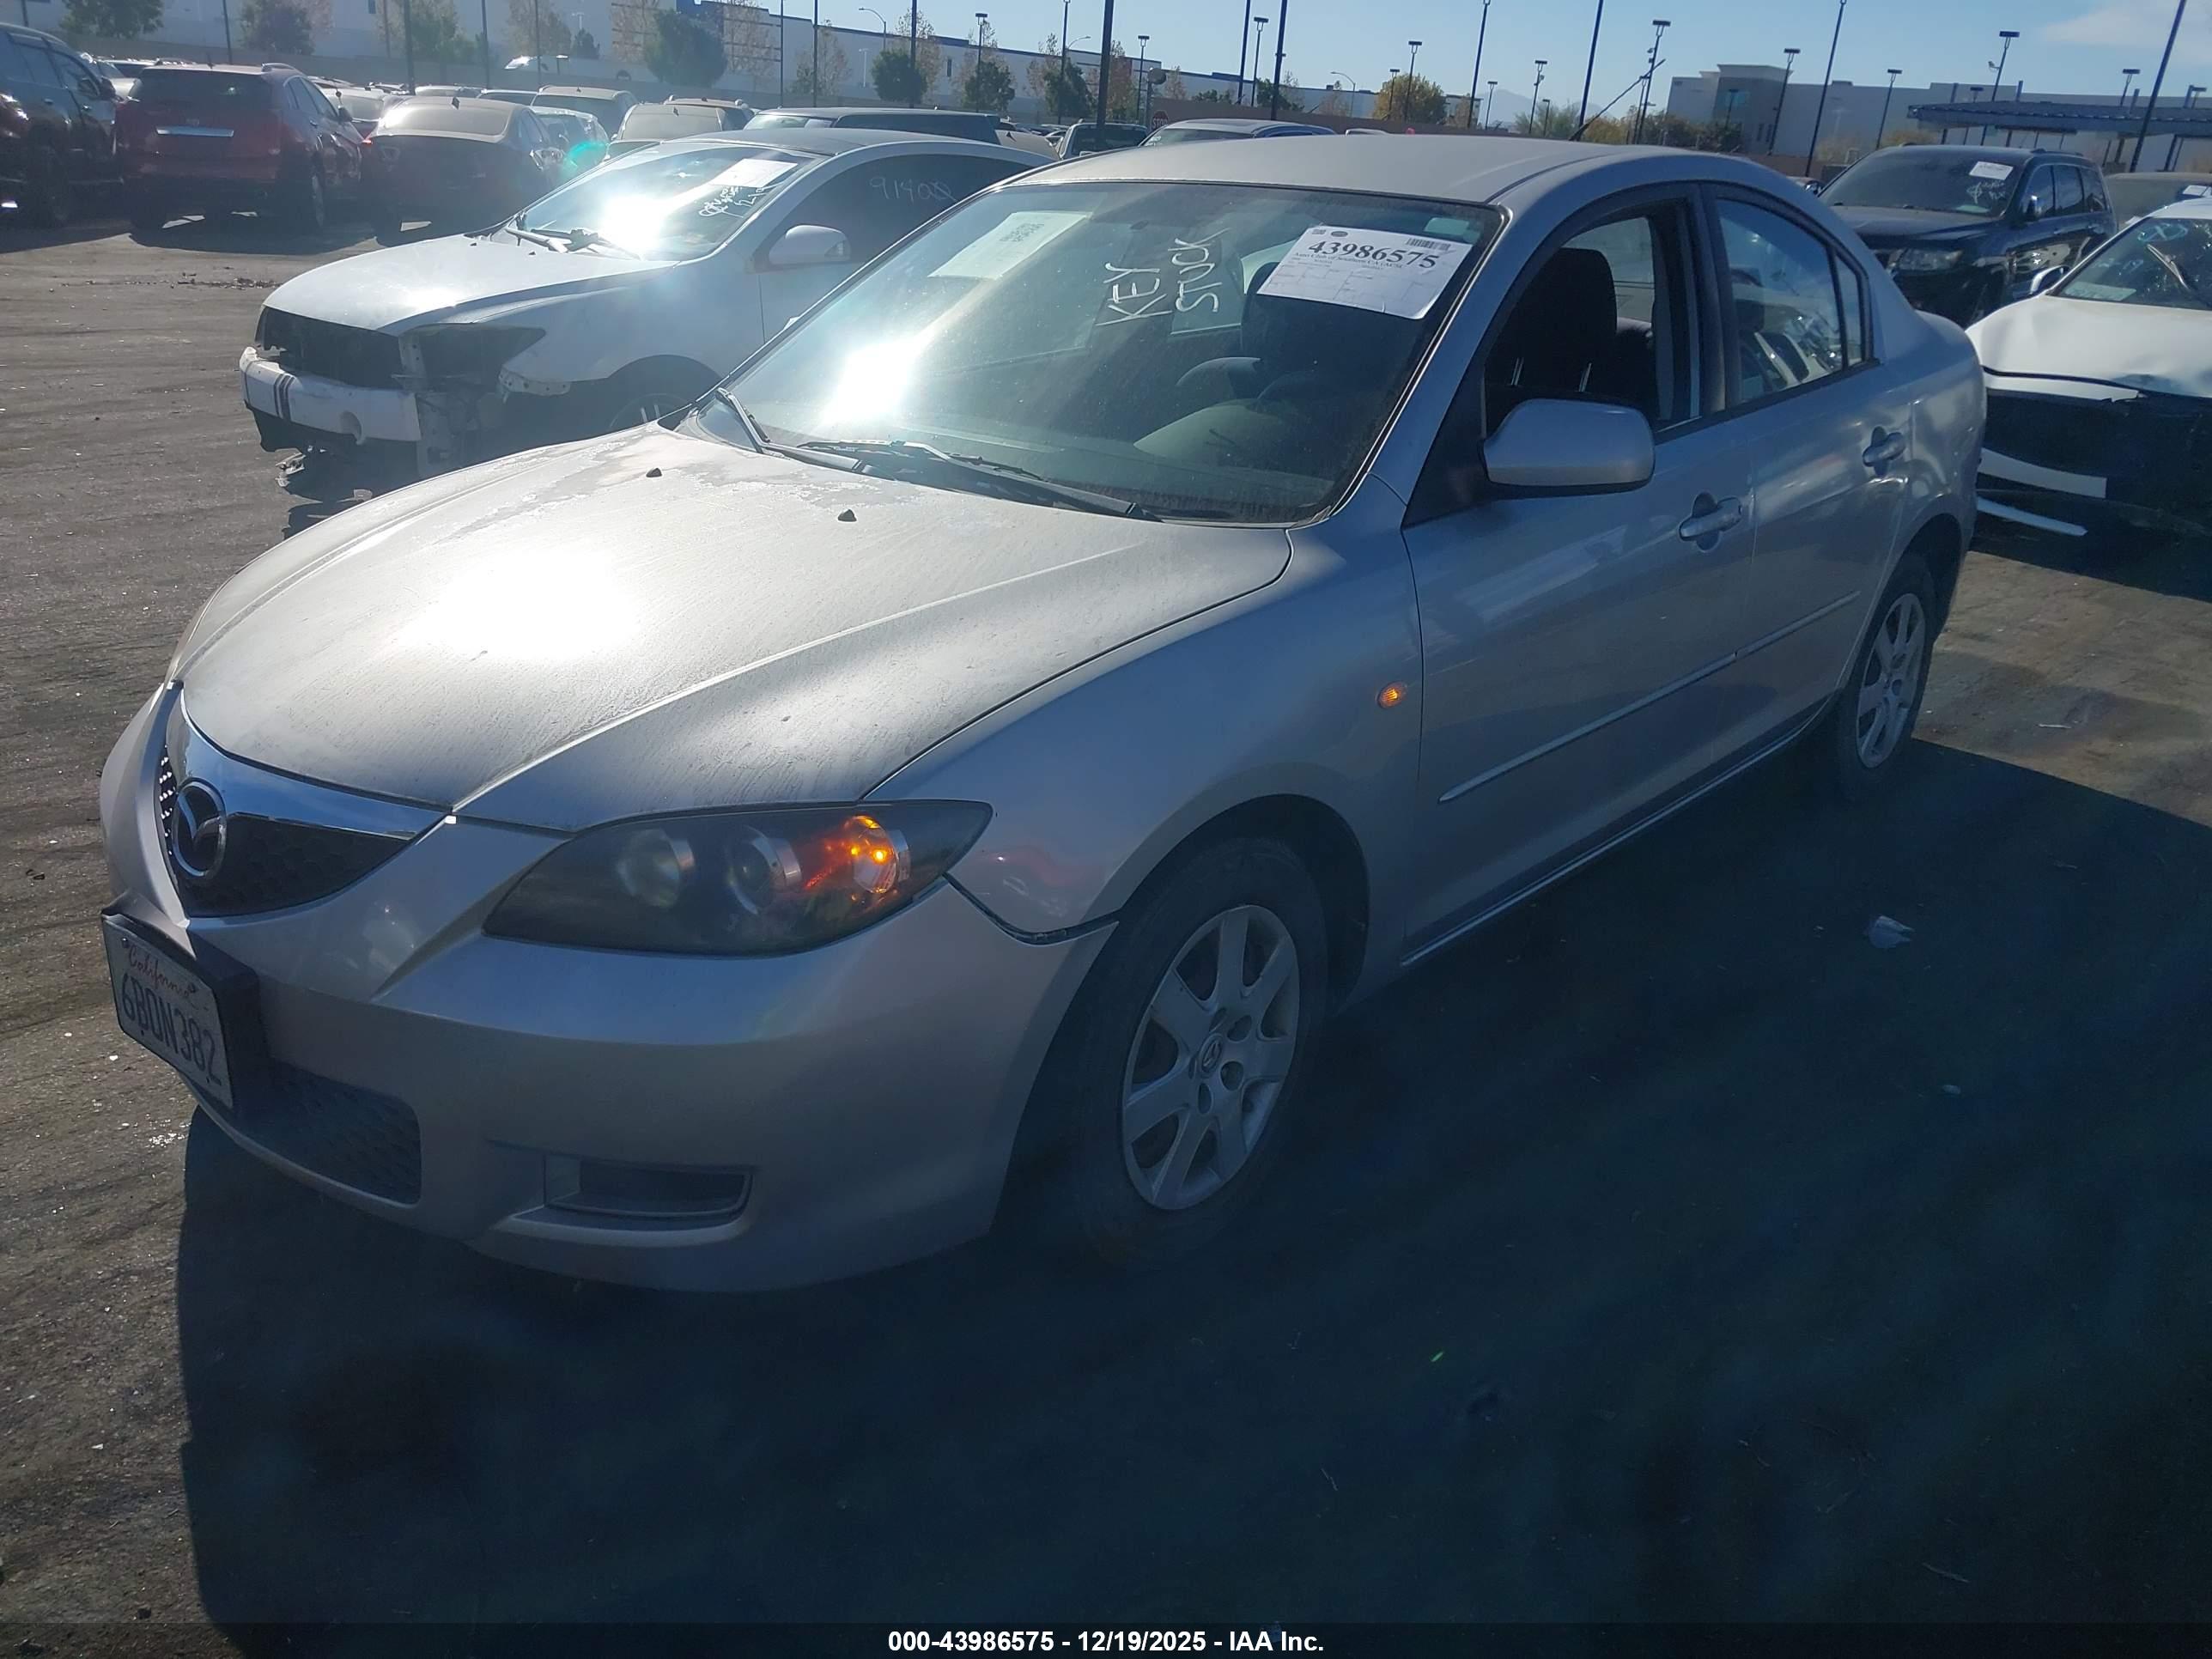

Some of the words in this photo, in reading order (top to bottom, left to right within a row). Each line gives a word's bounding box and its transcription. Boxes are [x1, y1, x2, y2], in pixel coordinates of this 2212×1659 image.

[1167, 228, 1230, 313] STUCK
[1308, 241, 1440, 269] 43986575
[1095, 262, 1173, 326] KEY
